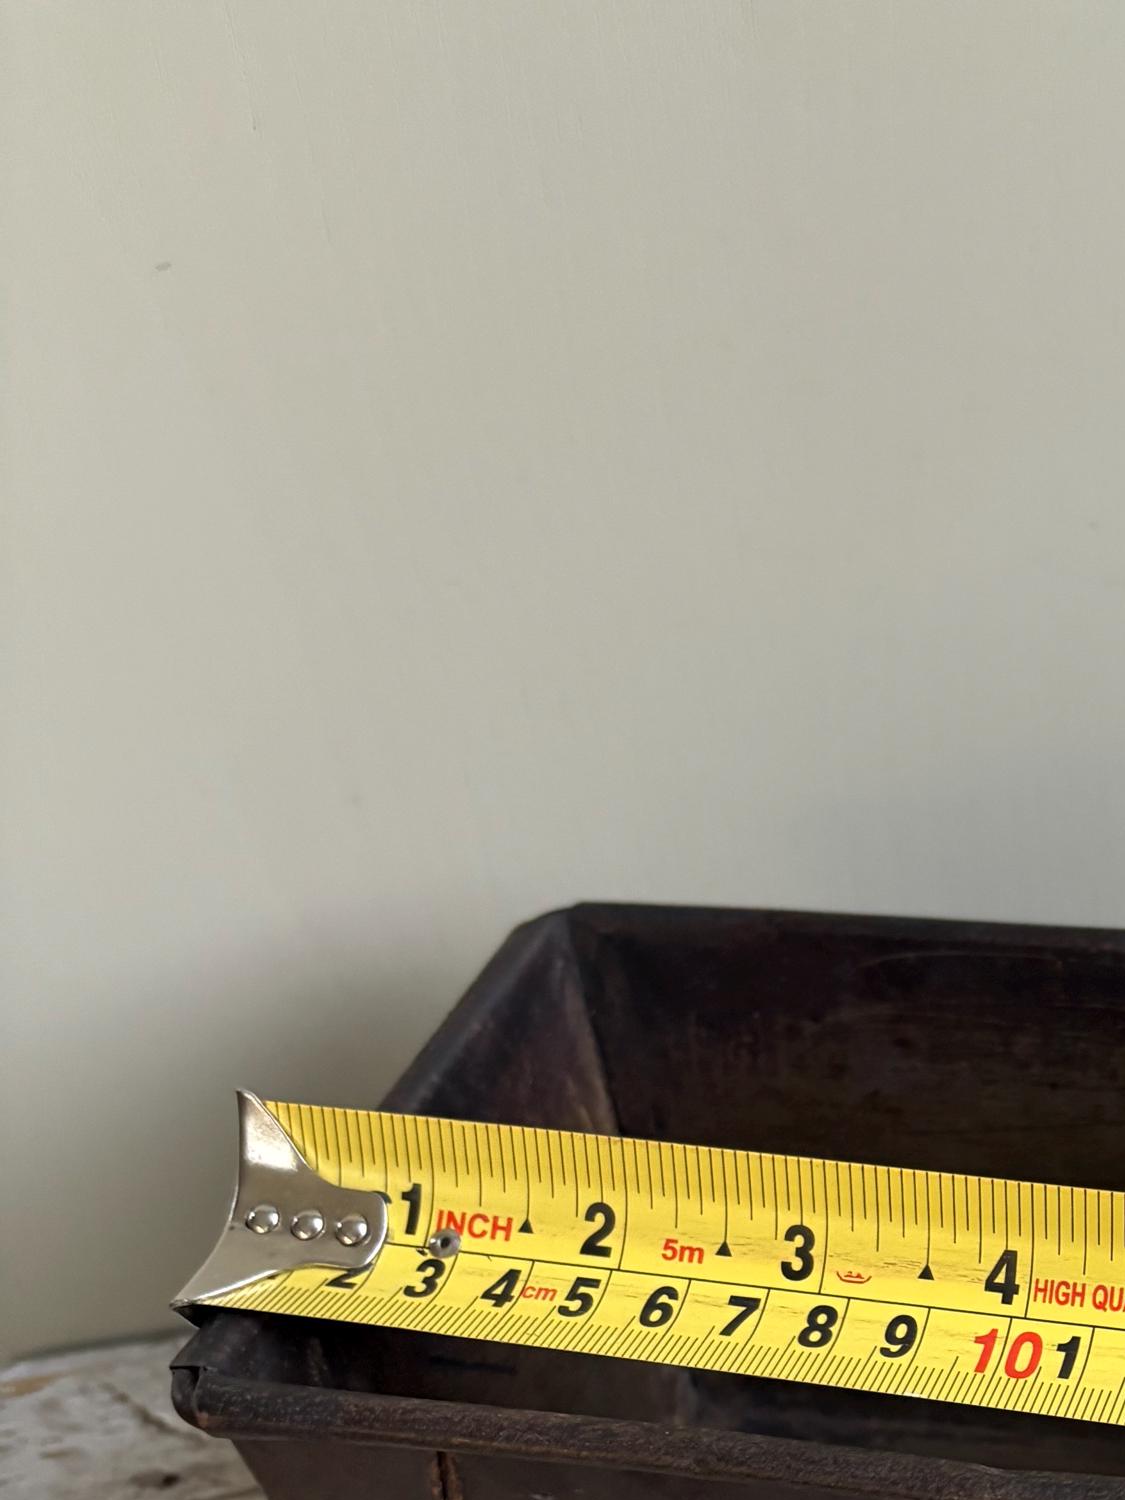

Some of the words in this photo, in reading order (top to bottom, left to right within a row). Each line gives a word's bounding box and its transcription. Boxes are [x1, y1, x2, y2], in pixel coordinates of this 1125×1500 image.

[401, 1183, 422, 1234] 1
[436, 1209, 513, 1242] INCH
[580, 1202, 616, 1256] 2
[661, 1239, 704, 1264] 5m
[780, 1225, 815, 1280] 3
[985, 1250, 1019, 1304] 4
[1034, 1279, 1085, 1308] HIGH
[404, 1260, 445, 1297] 3
[481, 1269, 522, 1307] 4
[522, 1283, 558, 1301] cm
[558, 1278, 601, 1316] 5
[638, 1286, 679, 1326] 6
[719, 1296, 760, 1336] 7
[798, 1305, 838, 1347] 8
[880, 1315, 918, 1357] 9
[974, 1328, 1042, 1378] 10
[1056, 1336, 1082, 1378] 1
